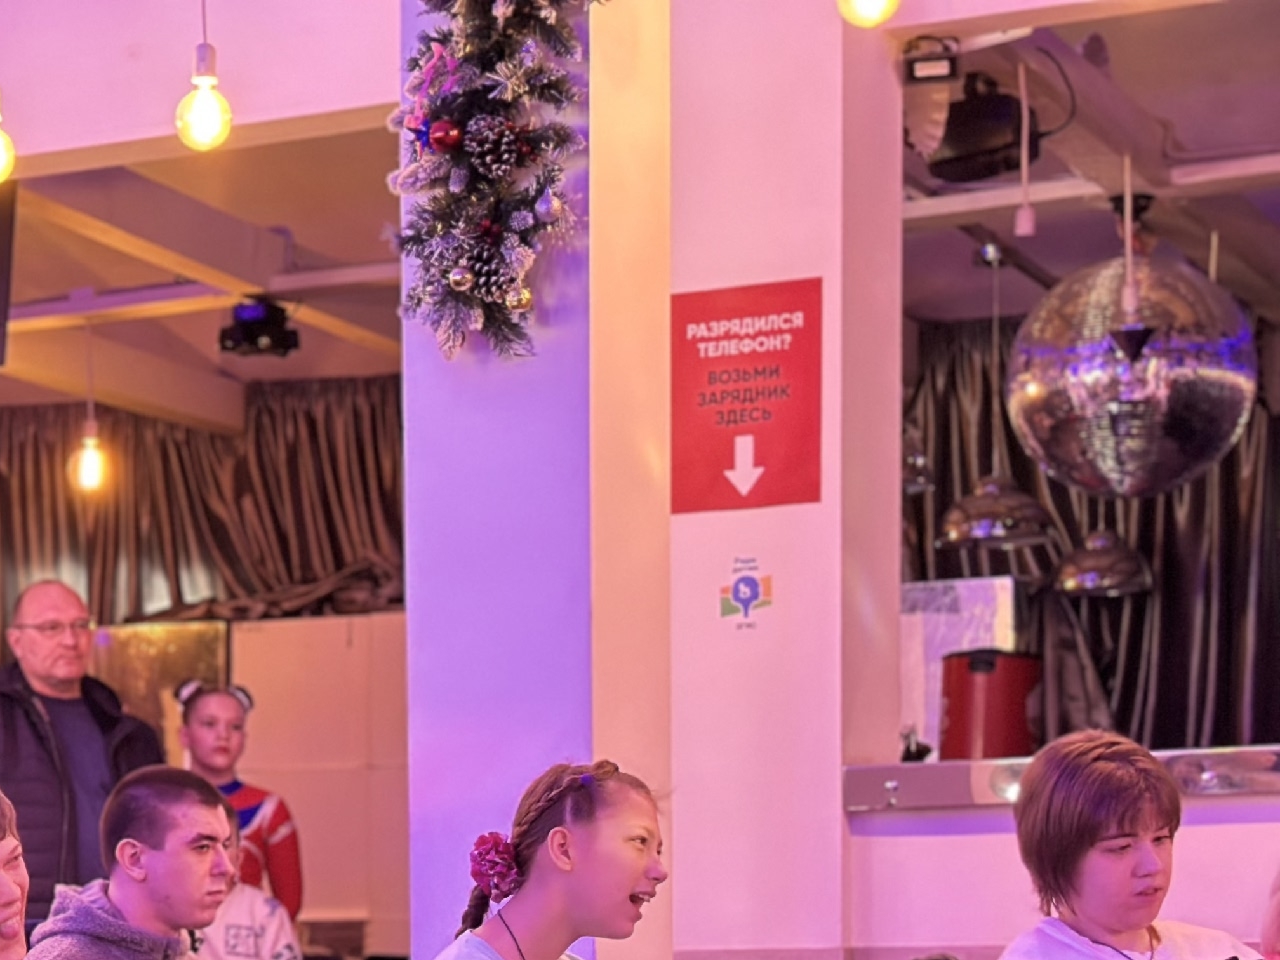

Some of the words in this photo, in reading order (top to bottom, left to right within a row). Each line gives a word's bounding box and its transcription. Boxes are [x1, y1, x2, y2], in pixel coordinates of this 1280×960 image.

[686, 311, 804, 340] РАЗРЯДИЛСЯ
[697, 333, 792, 358] ТЕЛЕФОН?
[708, 366, 780, 385] ВОЗЬМИ
[697, 384, 791, 407] ЗАРЯДНИК
[715, 408, 772, 426] ЗДЕСЬ
